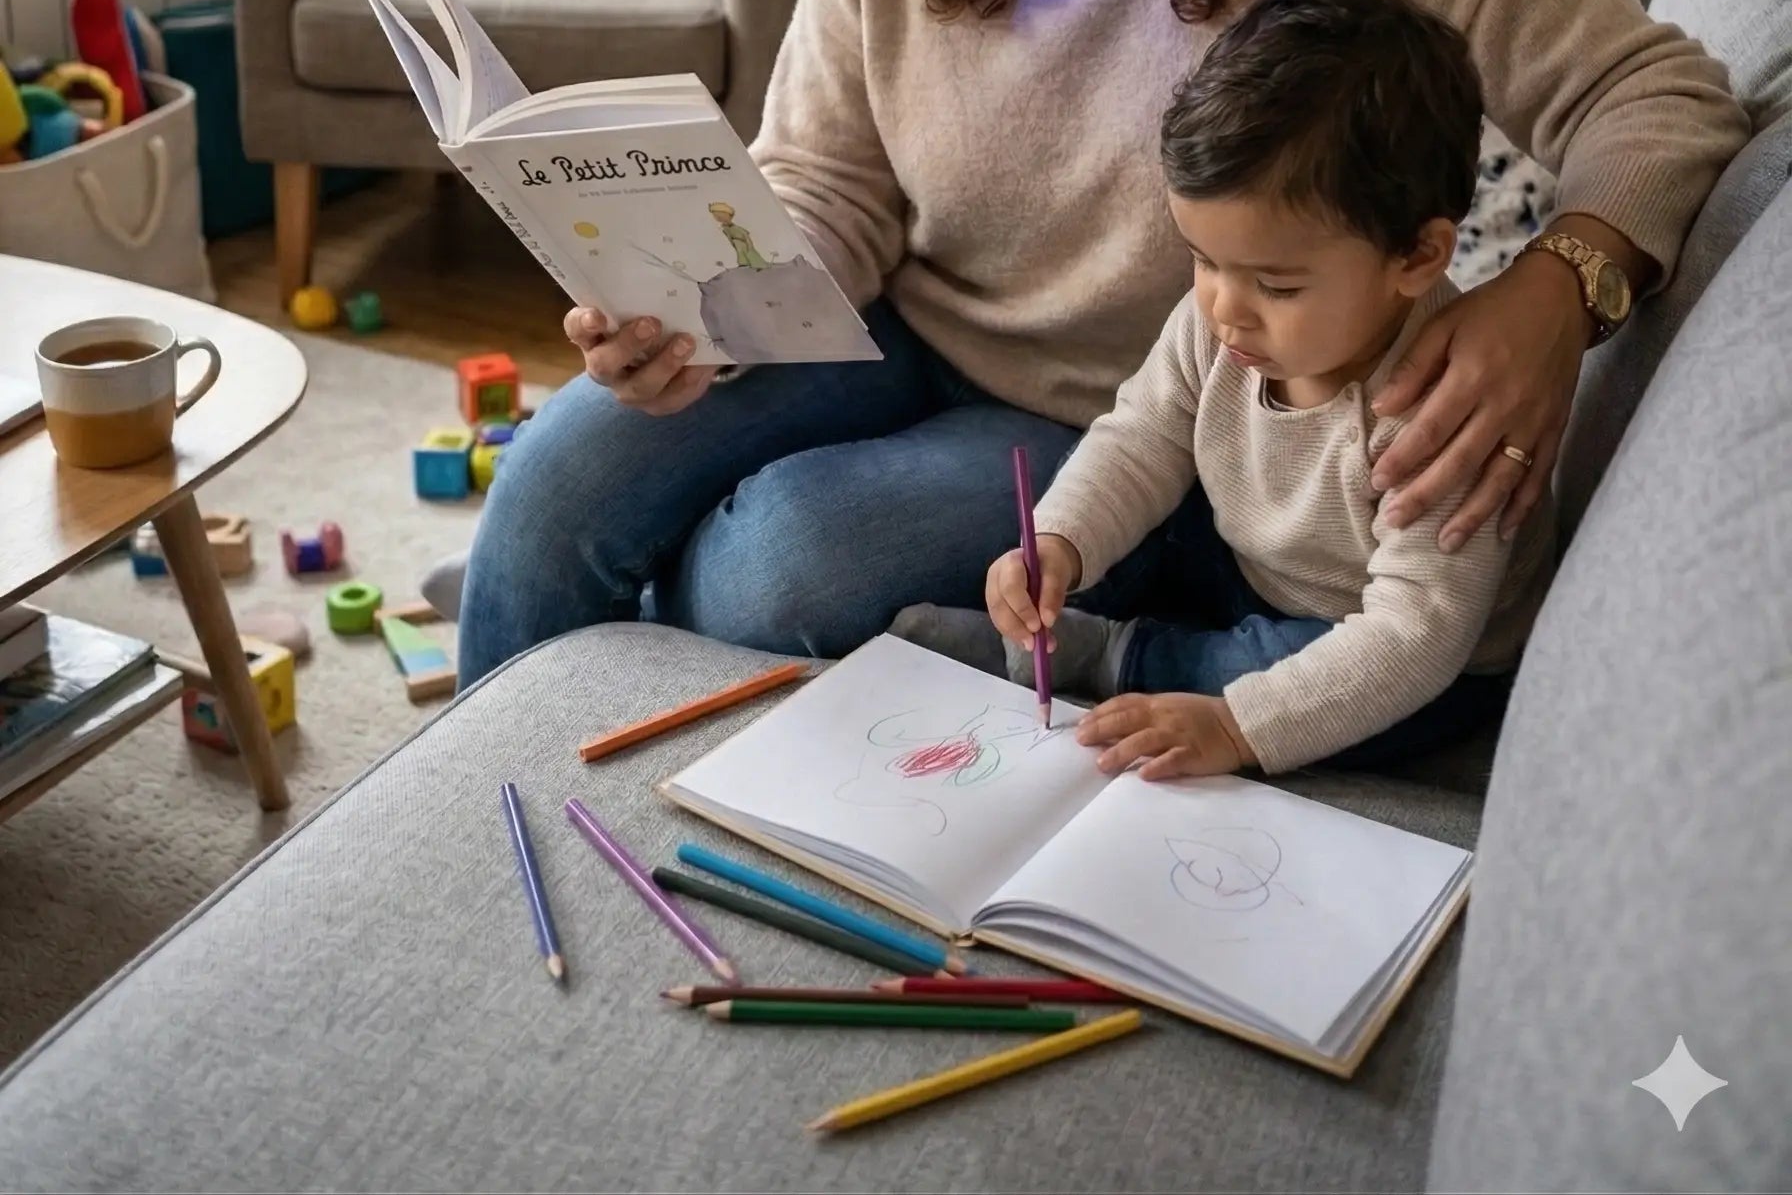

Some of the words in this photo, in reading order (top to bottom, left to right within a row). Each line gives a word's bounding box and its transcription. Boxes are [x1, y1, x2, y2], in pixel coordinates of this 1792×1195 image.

[518, 159, 551, 186] Le
[551, 155, 626, 183] Petit
[626, 149, 731, 176] Prince
